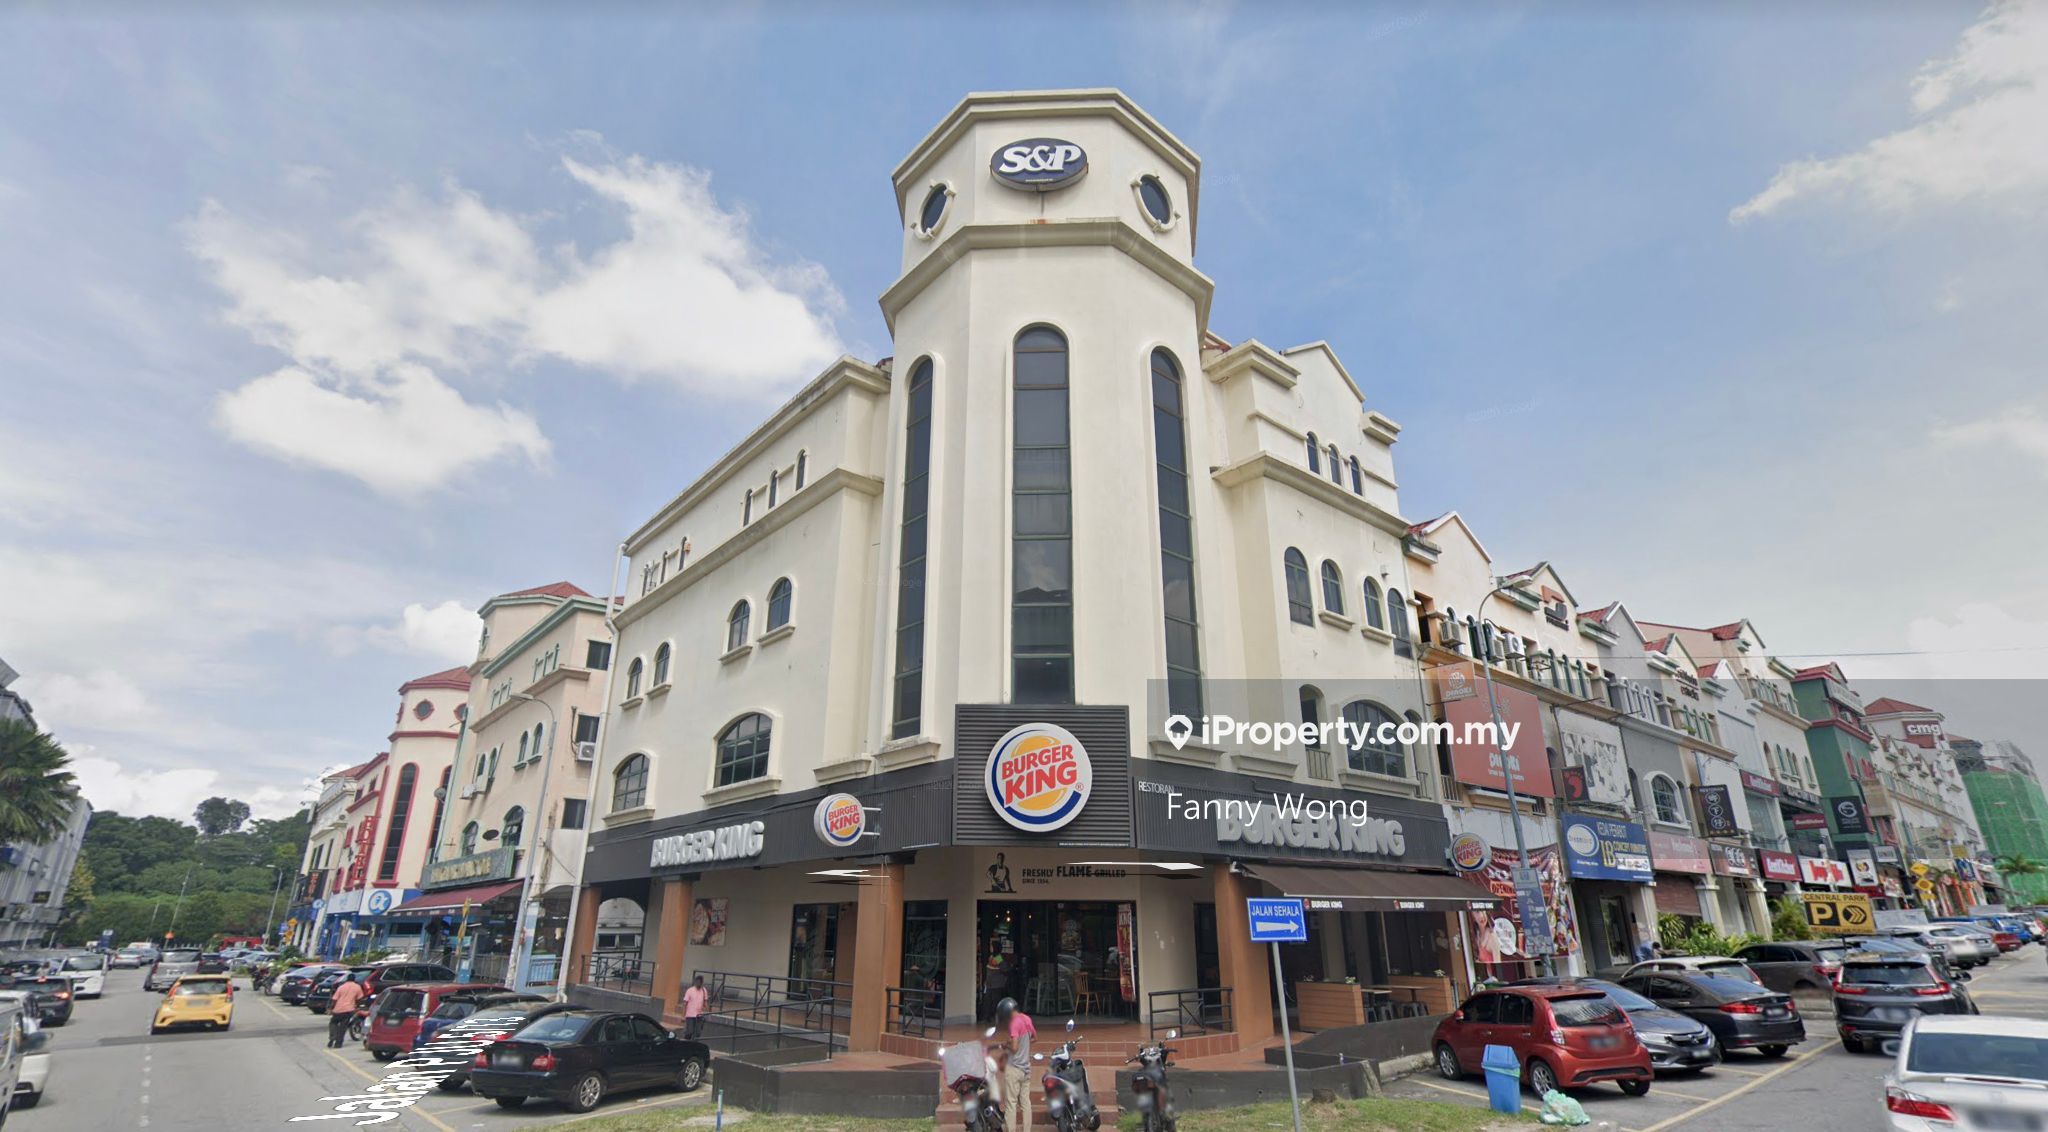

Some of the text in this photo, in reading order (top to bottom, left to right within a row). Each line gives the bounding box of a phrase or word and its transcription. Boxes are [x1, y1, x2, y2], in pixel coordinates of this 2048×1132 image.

[999, 145, 1082, 174] S&P
[1907, 724, 1941, 736] cmg
[1001, 744, 1074, 780] BURGER
[1004, 761, 1078, 806] KING
[1138, 780, 1175, 794] RESTORAN
[828, 804, 859, 820] BURGER
[829, 812, 860, 832] KING
[1216, 799, 1405, 856] BURGER KING
[650, 821, 765, 868] BURGER KING
[1456, 841, 1481, 853] BURGER
[1457, 849, 1482, 862] KING
[1022, 866, 1126, 878] FRESHLY FLAME GRILLED
[1804, 893, 1866, 902] CENTRAL PARK
[1251, 904, 1300, 917] JALAN SEHALA
[1809, 903, 1833, 925] P
